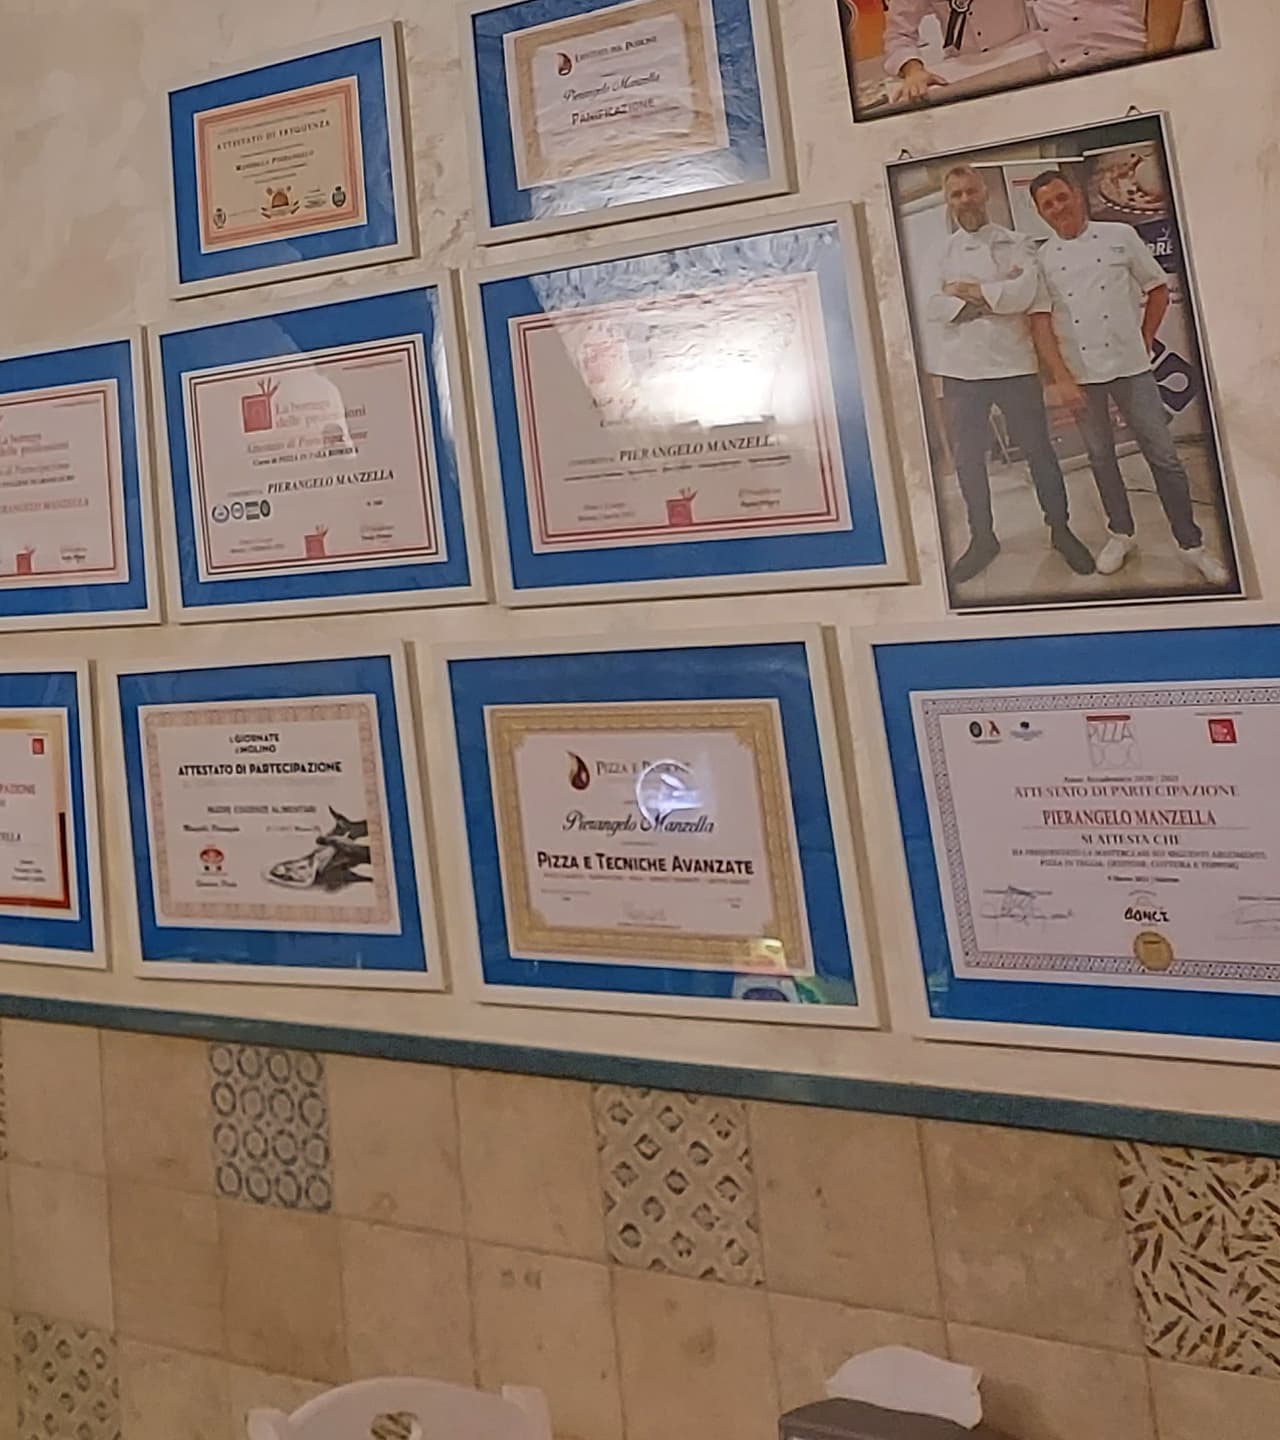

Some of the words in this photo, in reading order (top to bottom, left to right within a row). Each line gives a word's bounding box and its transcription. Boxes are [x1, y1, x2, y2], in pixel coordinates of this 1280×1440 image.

[619, 443, 703, 462] PIERANGELO
[268, 475, 333, 494] PIERANGELO
[336, 468, 394, 485] MANZELLA
[177, 763, 233, 776] ATTESTATO
[235, 763, 247, 774] DI
[249, 761, 343, 775] PARTECIPAZIONE
[1015, 786, 1088, 799] ATTESTATO
[1092, 787, 1109, 799] DI
[1110, 784, 1239, 798] PARTECIPAZIONE
[562, 810, 637, 837] Pierangelo
[1042, 809, 1132, 826] PIERANGELO
[1134, 809, 1217, 826] MANZELLA
[1081, 835, 1093, 845] SI
[1098, 834, 1150, 845] ATTESTA
[583, 854, 593, 870] E
